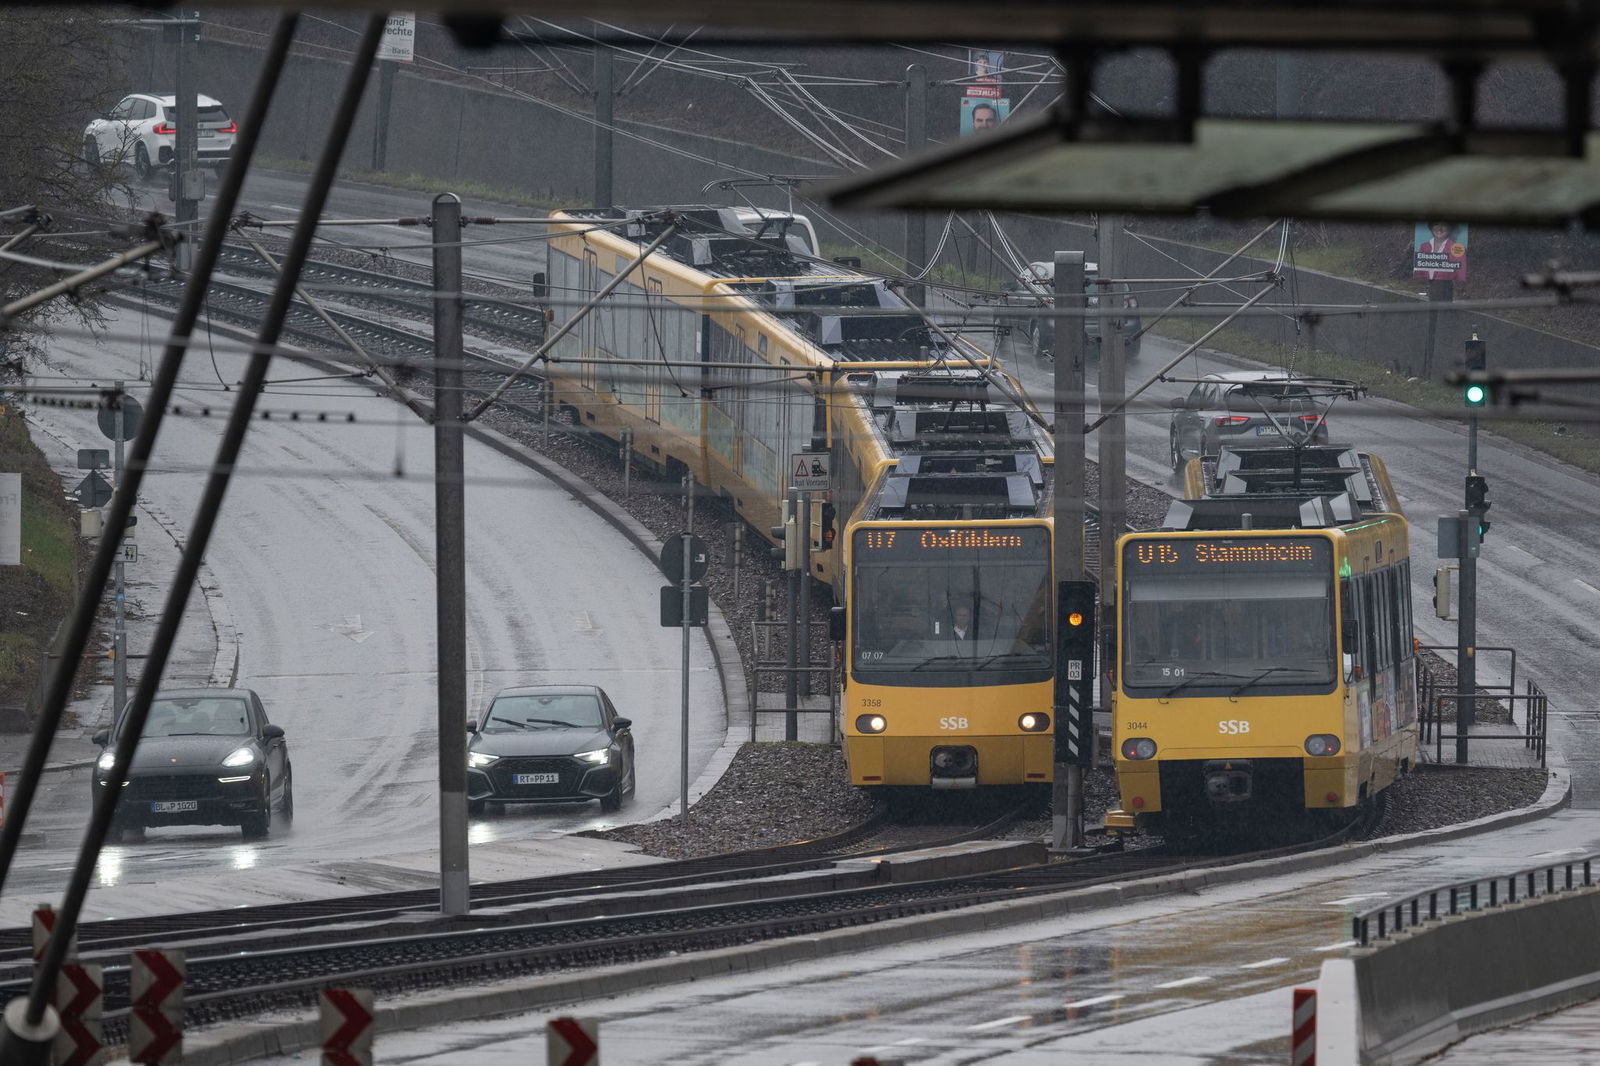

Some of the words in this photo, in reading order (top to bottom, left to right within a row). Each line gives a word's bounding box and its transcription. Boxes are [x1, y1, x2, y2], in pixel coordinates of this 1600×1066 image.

[1417, 252, 1448, 260] Elisabeth
[1417, 260, 1460, 268] Schick-Ebert
[1195, 542, 1313, 562] Stammheim
[862, 651, 871, 660] 07
[873, 651, 884, 660] 07
[1070, 662, 1080, 670] PR
[1070, 670, 1080, 678] 03
[1162, 667, 1171, 676] 15
[1174, 667, 1185, 677] 01
[861, 698, 882, 707] 3358
[939, 716, 968, 730] SSB
[1127, 721, 1148, 730] 3044
[1218, 719, 1250, 735] SSB
